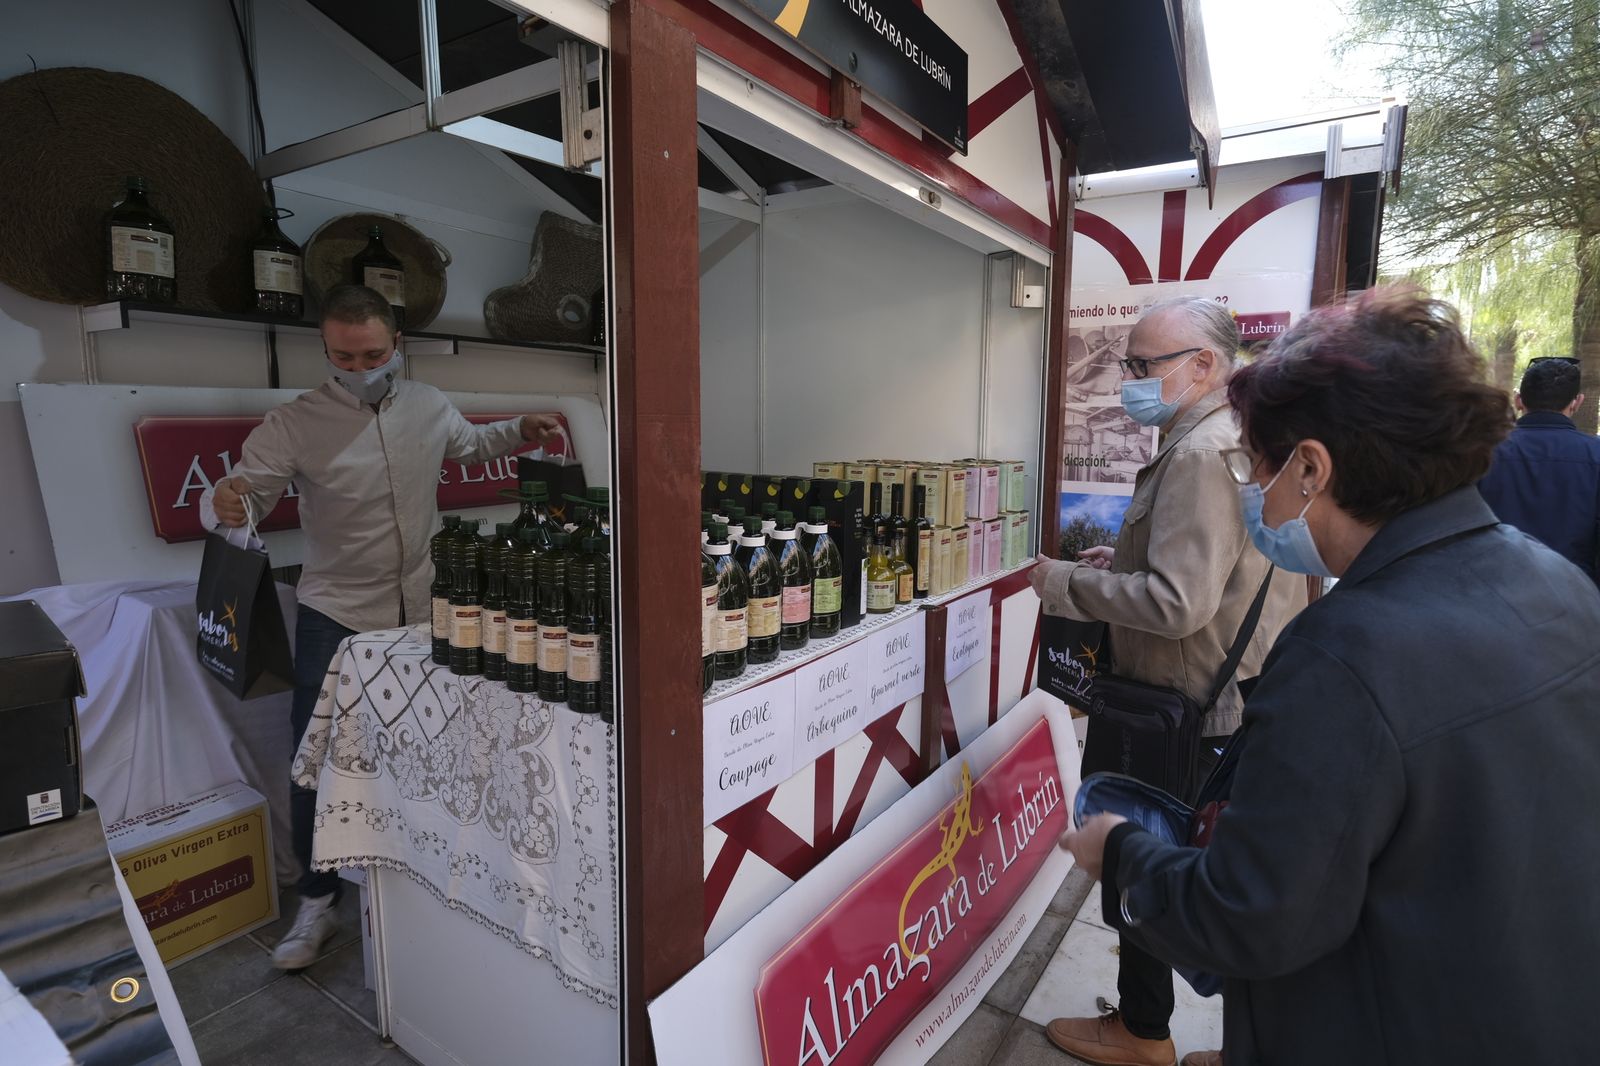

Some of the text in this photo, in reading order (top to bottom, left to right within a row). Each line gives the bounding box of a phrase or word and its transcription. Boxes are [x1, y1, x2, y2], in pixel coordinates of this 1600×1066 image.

[905, 37, 919, 65] DE
[920, 51, 952, 92] LUBRÍN
[1069, 305, 1104, 319] miendo
[1107, 303, 1117, 316] lo
[1119, 304, 1140, 319] que
[1064, 453, 1110, 468] dicación.
[901, 663, 922, 682] verde
[718, 753, 778, 791] Coupage
[133, 853, 168, 873] Oliva
[171, 836, 214, 858] Virgen
[217, 823, 250, 842] Extra
[172, 901, 186, 914] de
[190, 872, 250, 906] Lubrín
[797, 771, 1061, 1066] Almazara de Lubrín
[914, 912, 1028, 1049] www.almazaradelubrin.com
